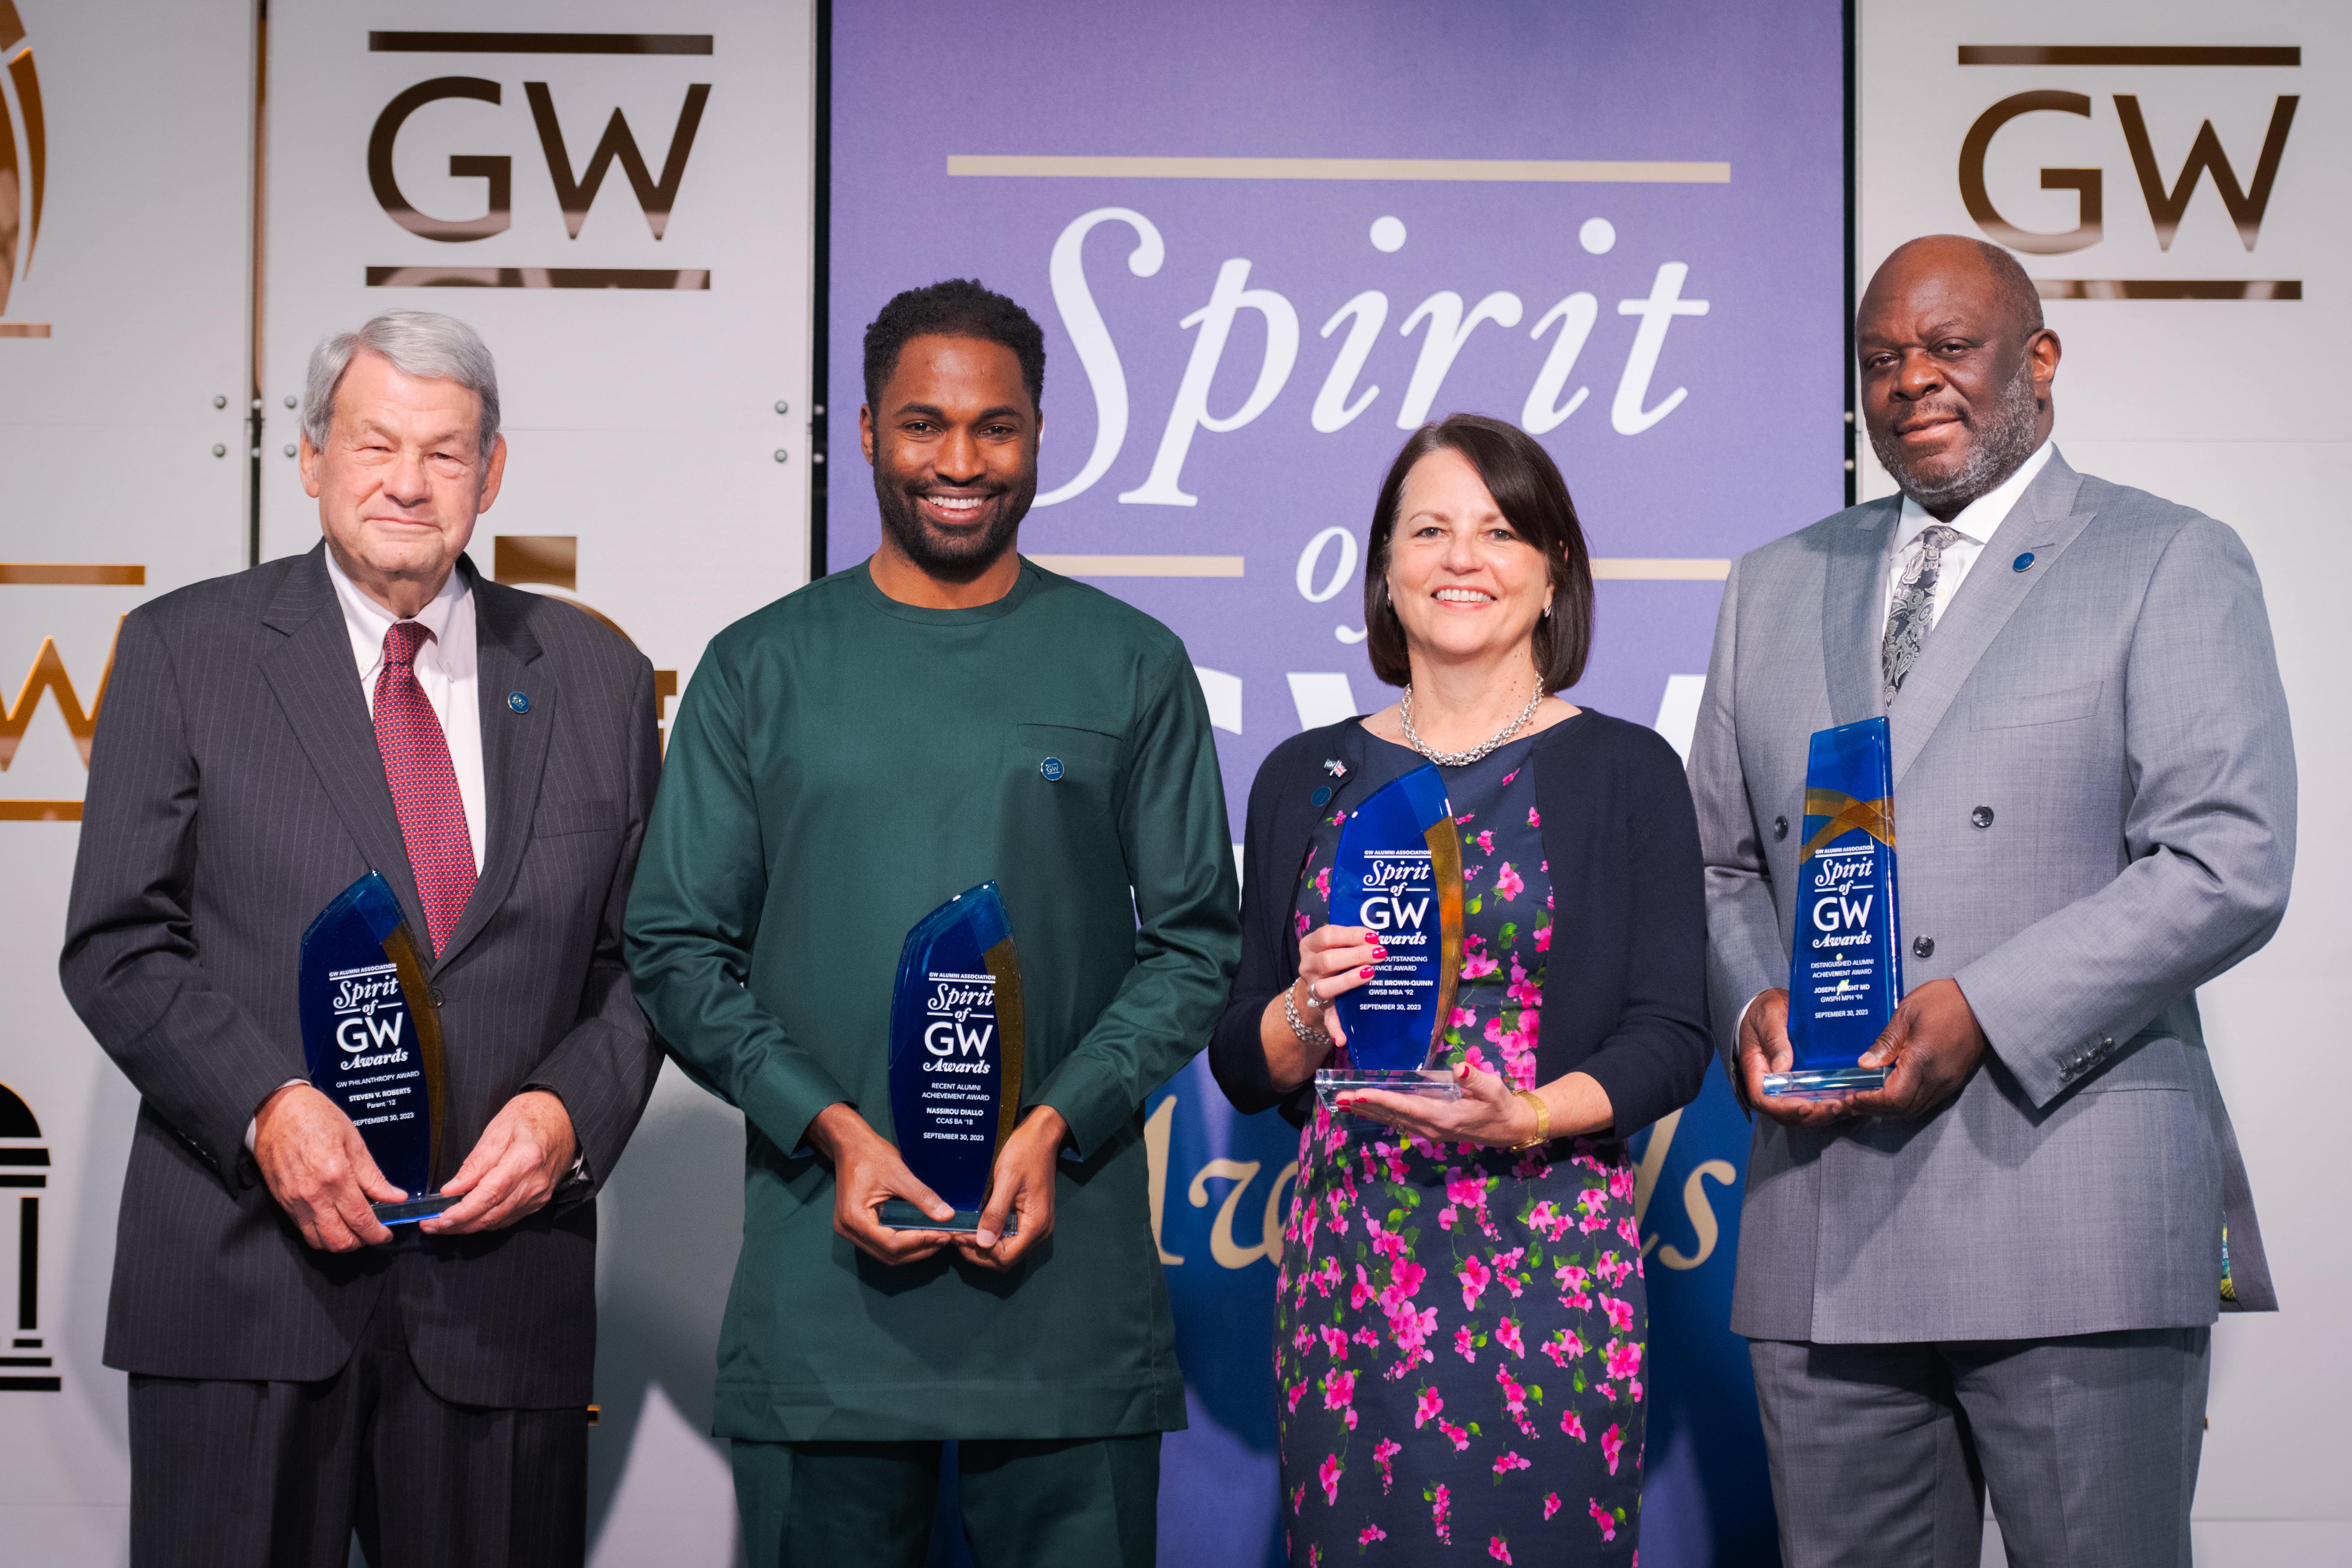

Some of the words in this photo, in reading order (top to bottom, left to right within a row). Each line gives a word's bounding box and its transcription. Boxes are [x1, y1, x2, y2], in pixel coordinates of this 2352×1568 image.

[368, 76, 712, 243] GW
[1959, 89, 2301, 255] GW
[1032, 207, 1710, 508] Spirit
[1296, 526, 1368, 644] o
[1363, 860, 1431, 886] Spirit
[1815, 856, 1874, 887] Spirit
[1390, 882, 1408, 896] of
[1839, 880, 1854, 895] of
[1360, 896, 1429, 929] GW
[1813, 894, 1873, 931] GW
[1376, 931, 1427, 945] wards
[1812, 930, 1872, 948] Awards
[361, 963, 397, 972] ASSOCIATION
[1811, 960, 1851, 968] DISTINGUISHED
[1812, 970, 1850, 978] ACHIEVEMENT
[333, 975, 398, 1009] Spirit
[928, 983, 995, 1010] Spirit
[362, 999, 379, 1015] of
[954, 1007, 972, 1022] of
[1815, 1010, 1846, 1019] SEPTEMBER
[336, 1012, 403, 1052] GW
[925, 1022, 993, 1057] GW
[341, 1048, 408, 1070] Awards
[923, 1058, 990, 1074] Awards
[348, 1074, 395, 1086] PHILANTHROPY
[396, 1071, 420, 1080] AWARD
[349, 1094, 374, 1102] STEVEN
[382, 1087, 412, 1097] ROBERTS
[353, 1115, 388, 1126] SEPTEMBER
[399, 1112, 414, 1120] 2023
